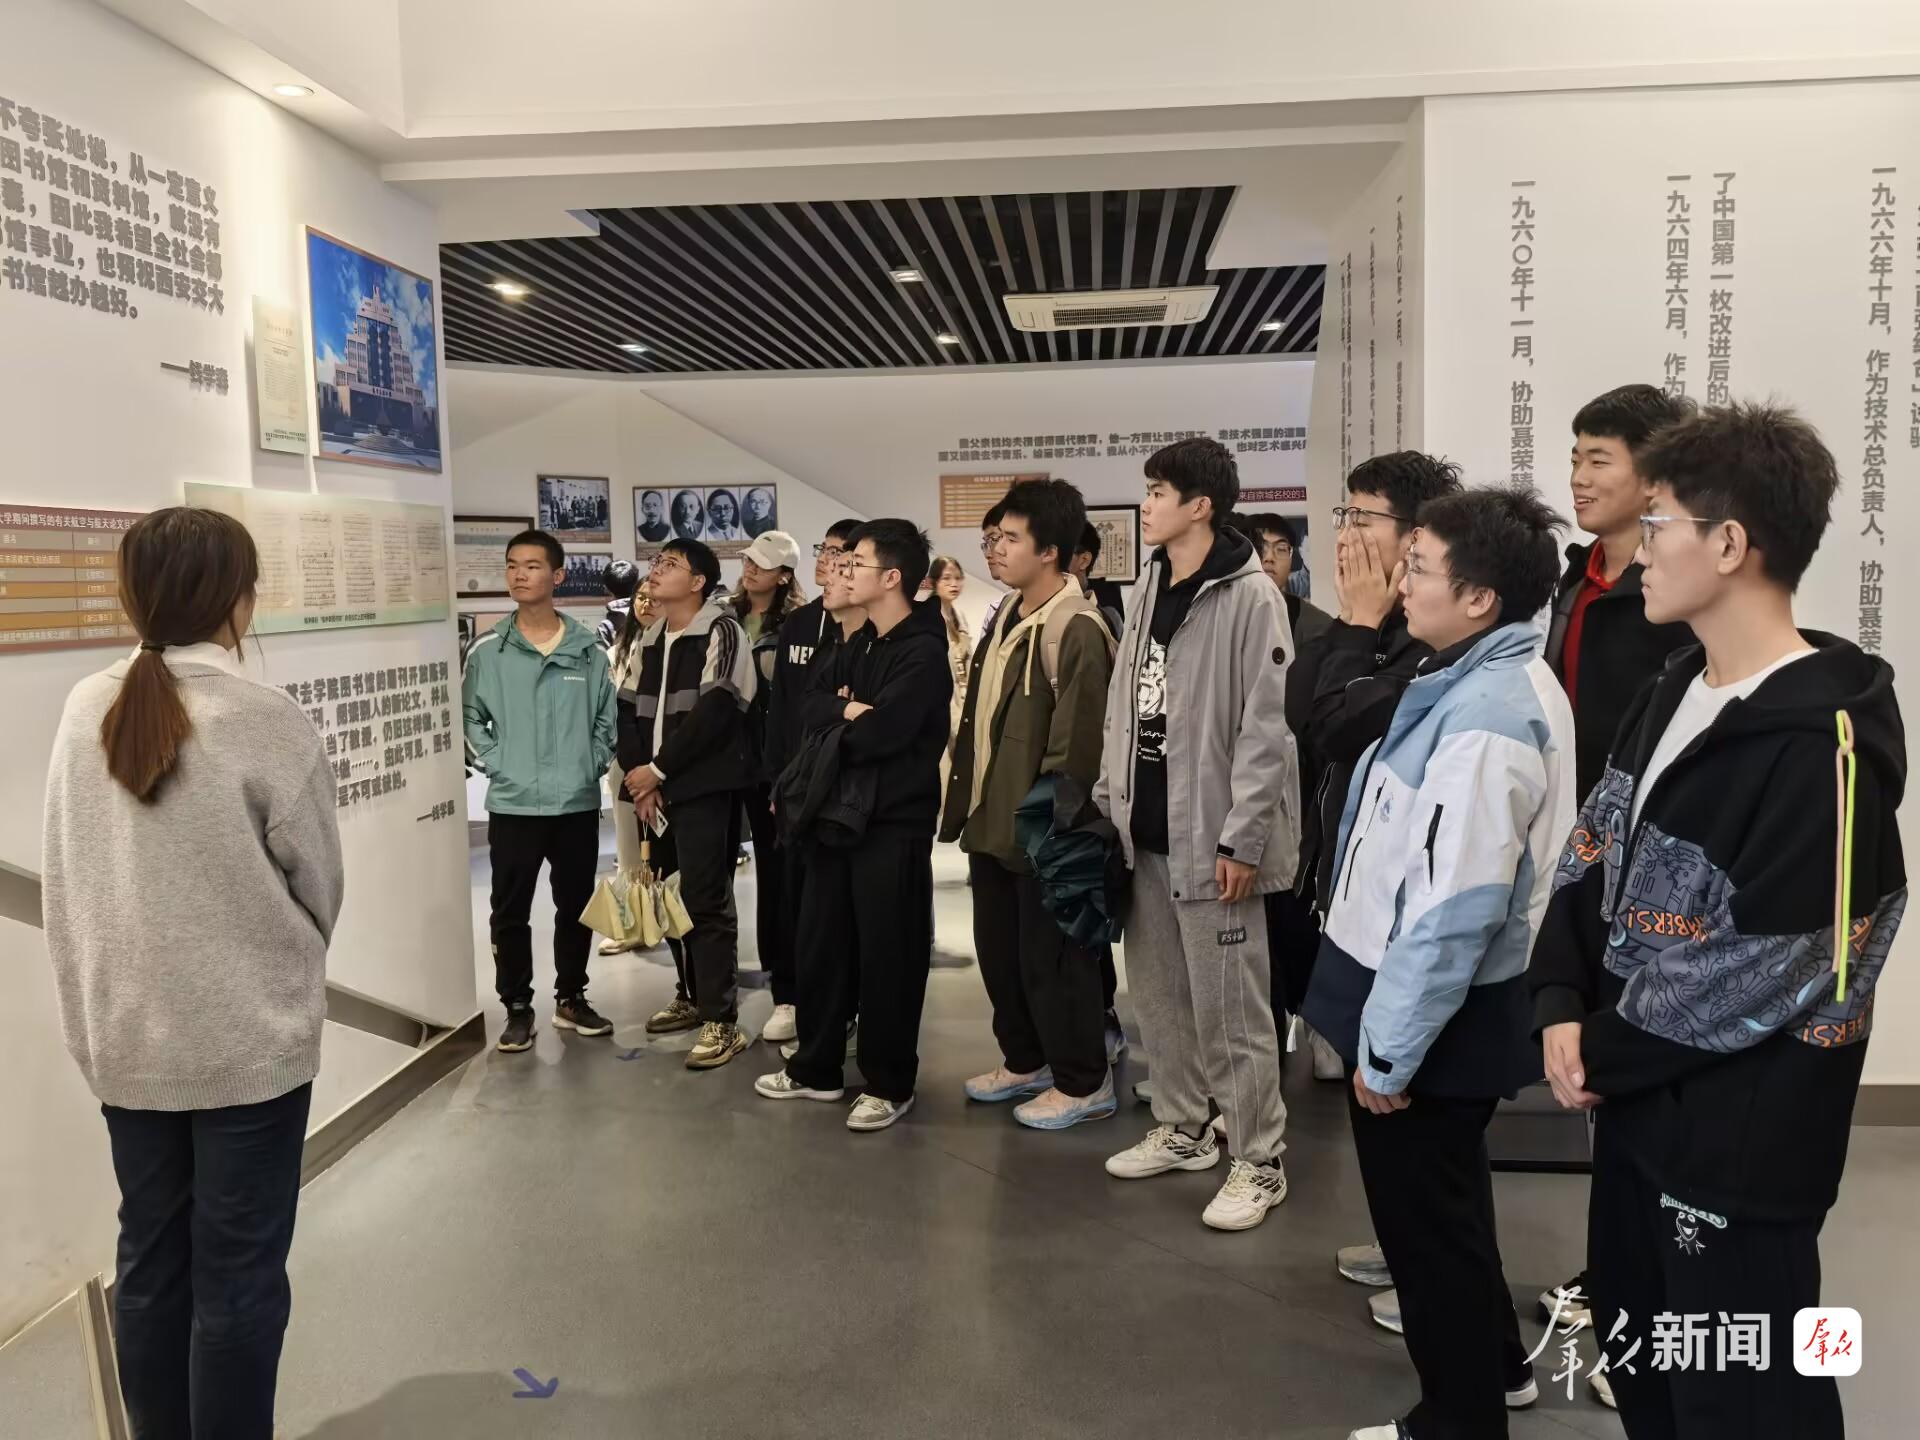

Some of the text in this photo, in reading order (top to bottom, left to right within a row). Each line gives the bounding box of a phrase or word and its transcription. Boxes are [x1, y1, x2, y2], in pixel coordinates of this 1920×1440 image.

[1707, 172, 1736, 404] 了中国第一枚改进后的
[1858, 167, 1897, 655] 一九六六年十月，作为技术总负责人，协助聂荣
